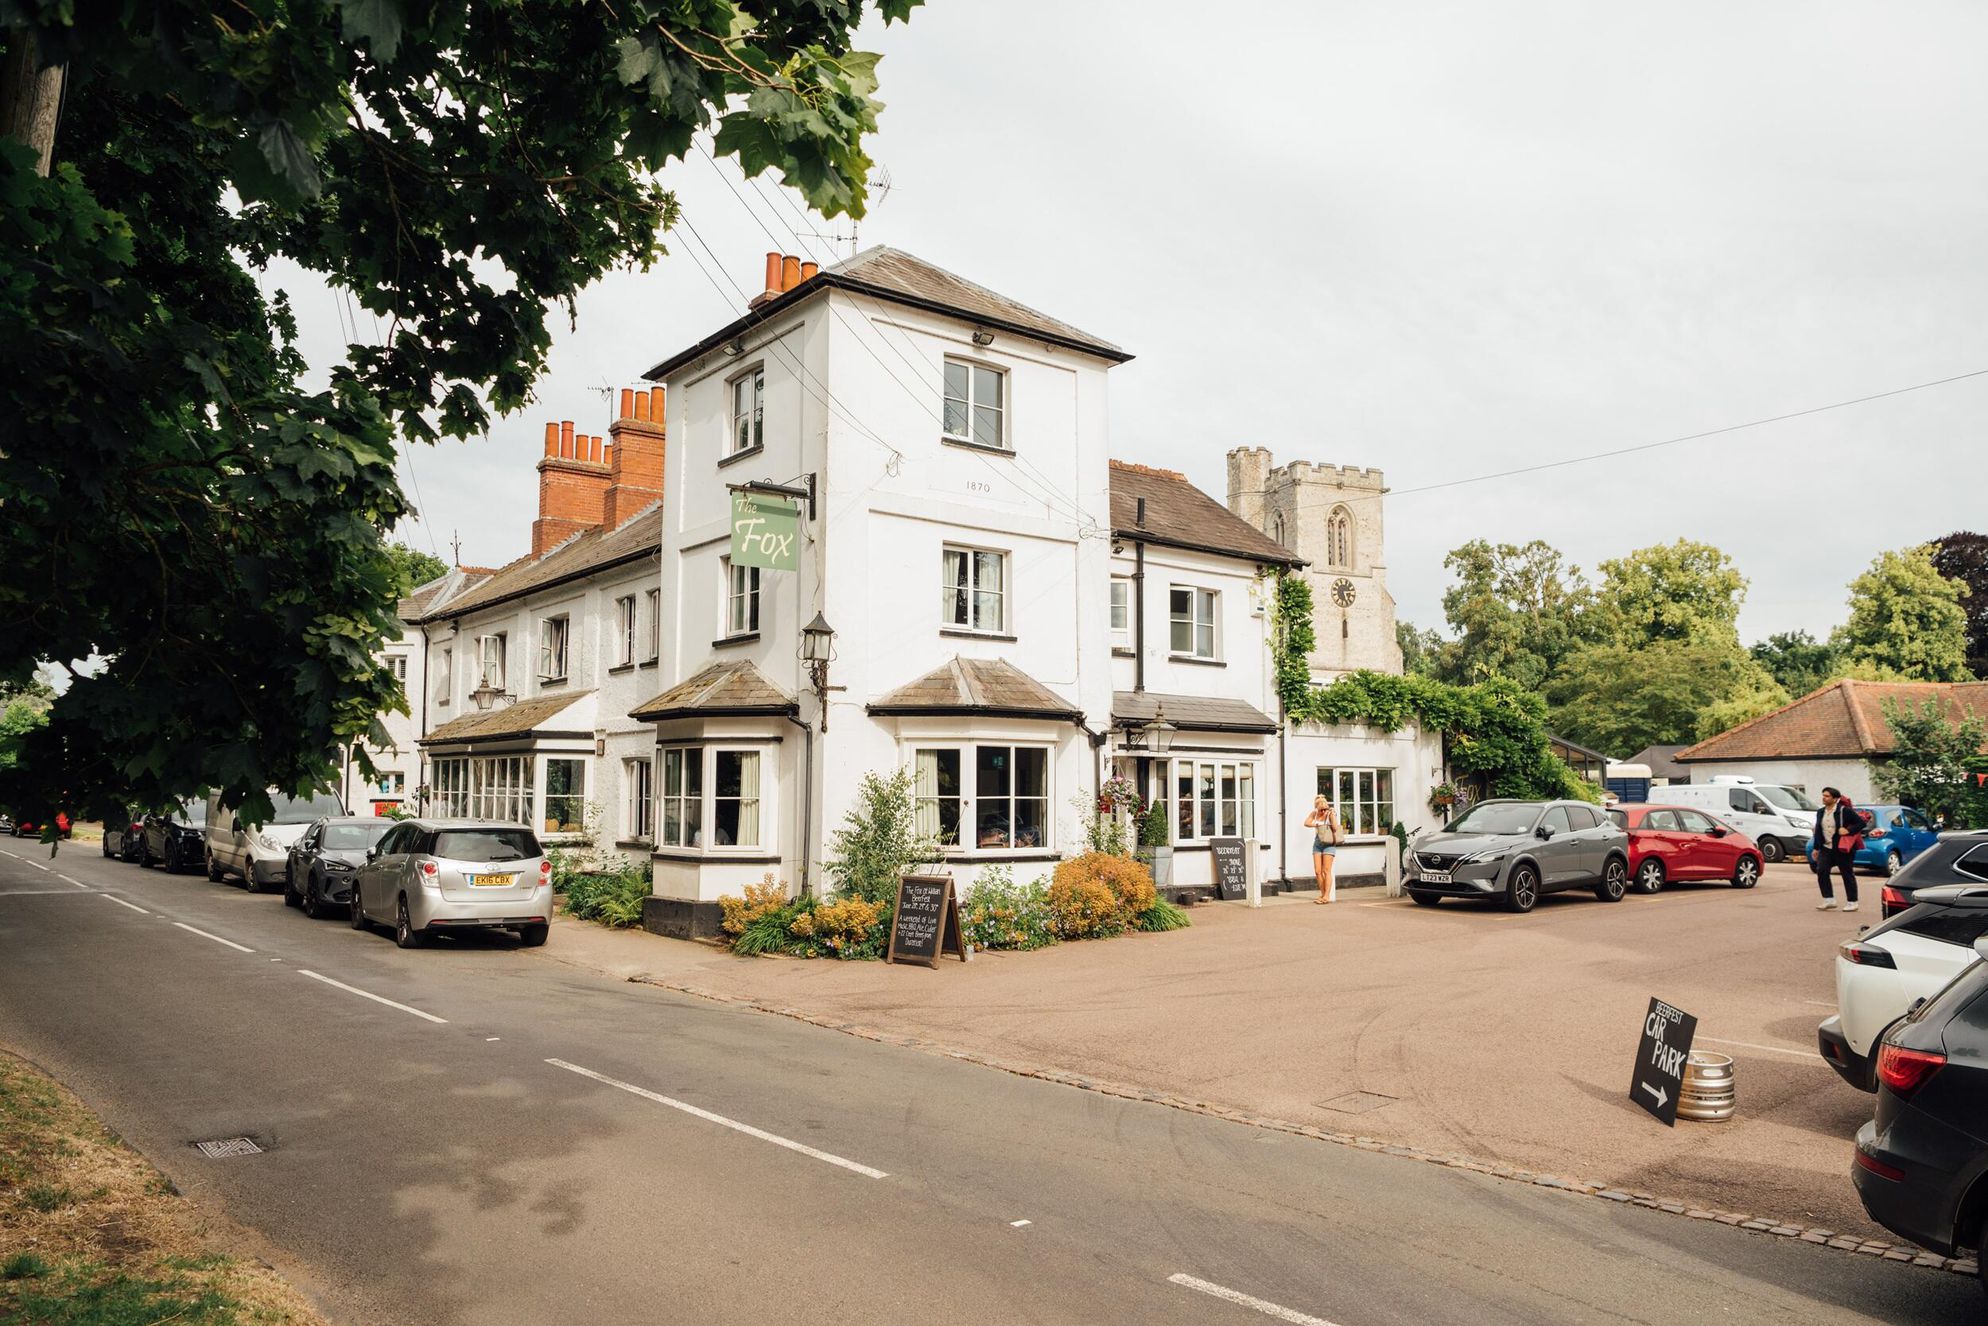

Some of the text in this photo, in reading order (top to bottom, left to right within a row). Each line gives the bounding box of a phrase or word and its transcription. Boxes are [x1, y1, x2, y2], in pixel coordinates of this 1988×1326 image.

[966, 480, 991, 493] 1870
[736, 497, 757, 514] The
[735, 518, 793, 565] Fox
[475, 876, 510, 884] EK16 CBX
[905, 885, 913, 895] The
[1656, 1001, 1684, 1024] BEERFEST
[1645, 1012, 1667, 1042] CAR
[1651, 1040, 1686, 1080] PARK
